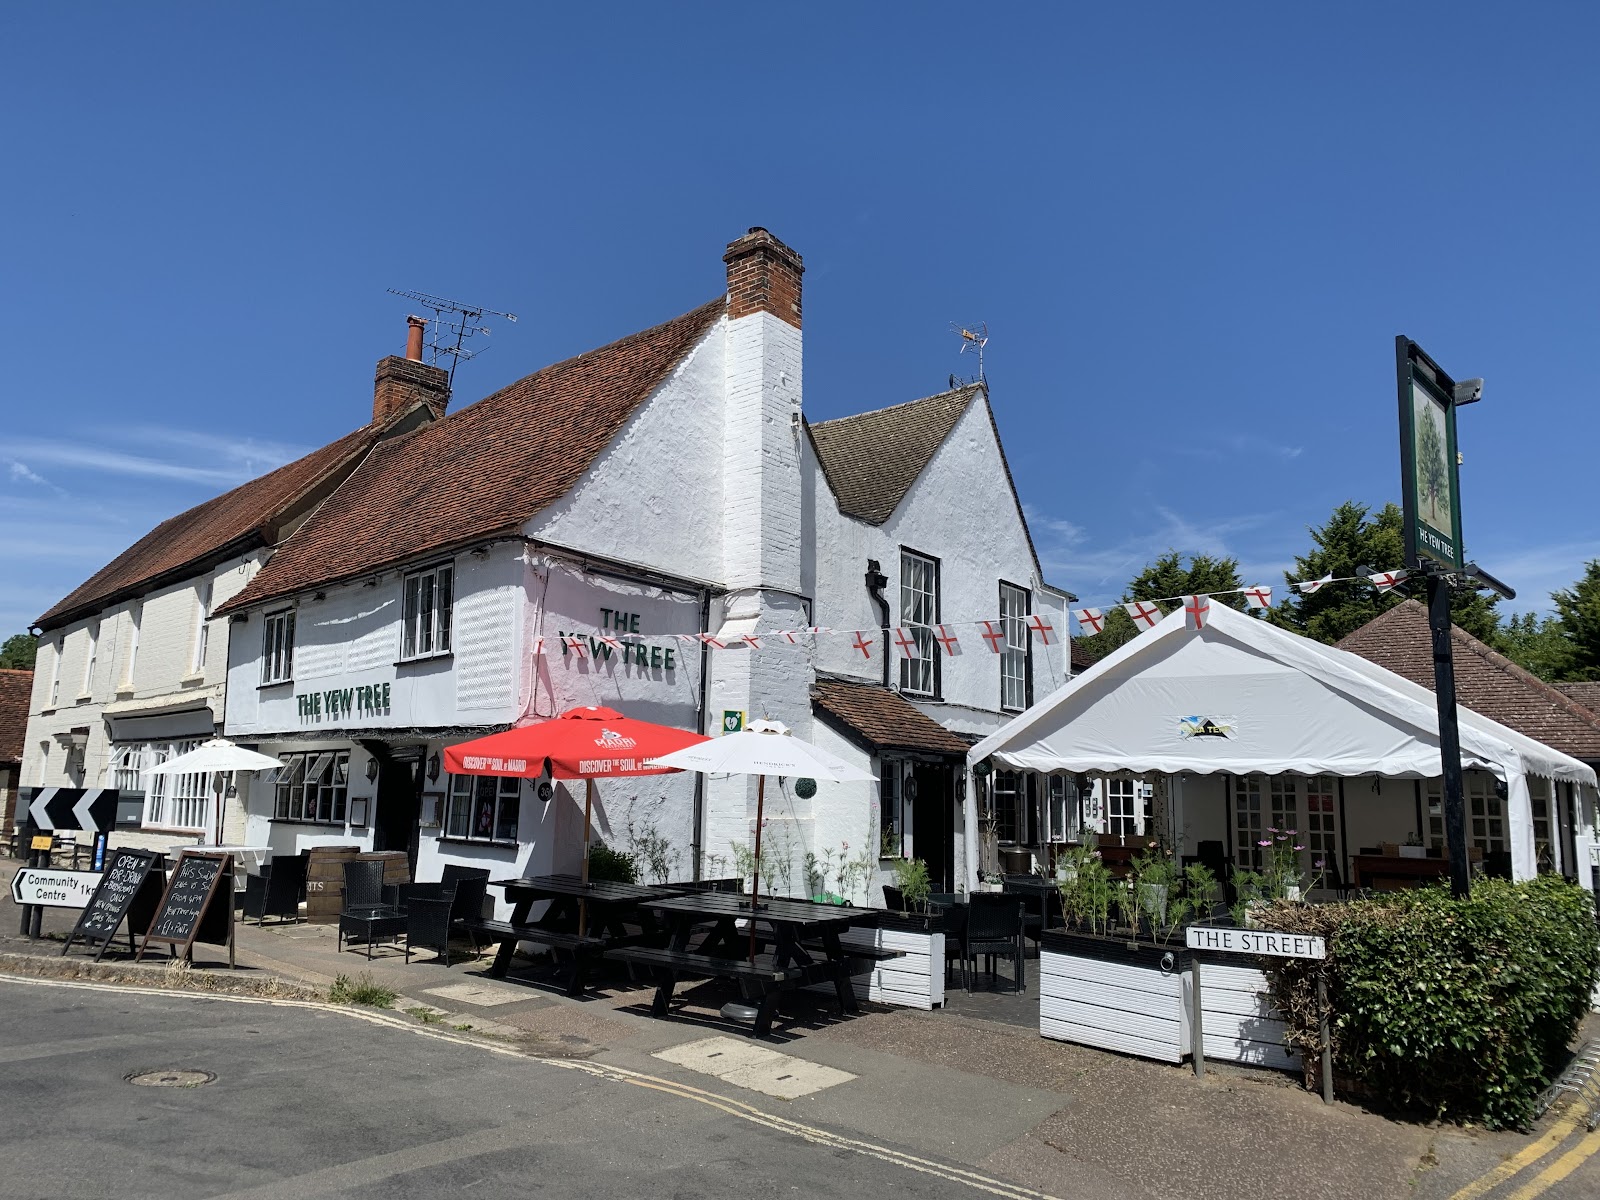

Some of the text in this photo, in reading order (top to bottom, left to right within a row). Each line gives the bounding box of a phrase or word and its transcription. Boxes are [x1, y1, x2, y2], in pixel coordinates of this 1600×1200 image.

[1428, 532, 1441, 551] YEW
[1440, 540, 1454, 559] TREE
[600, 607, 640, 634] THE
[558, 630, 675, 670] YW TREE
[296, 682, 391, 717] THE YEW TREE
[462, 756, 487, 770] DISCOVER
[491, 757, 504, 771] SOUL
[508, 758, 527, 773] MADRID
[579, 759, 612, 774] DISCOVER
[612, 758, 620, 767] THE
[619, 758, 637, 772] SOUL
[637, 762, 643, 771] OF
[117, 855, 140, 870] OPEN
[28, 874, 79, 889] Community
[36, 888, 67, 901] Centre
[109, 893, 127, 903] ONLY
[170, 892, 188, 902] FROM
[1193, 930, 1317, 955] THE STREET
